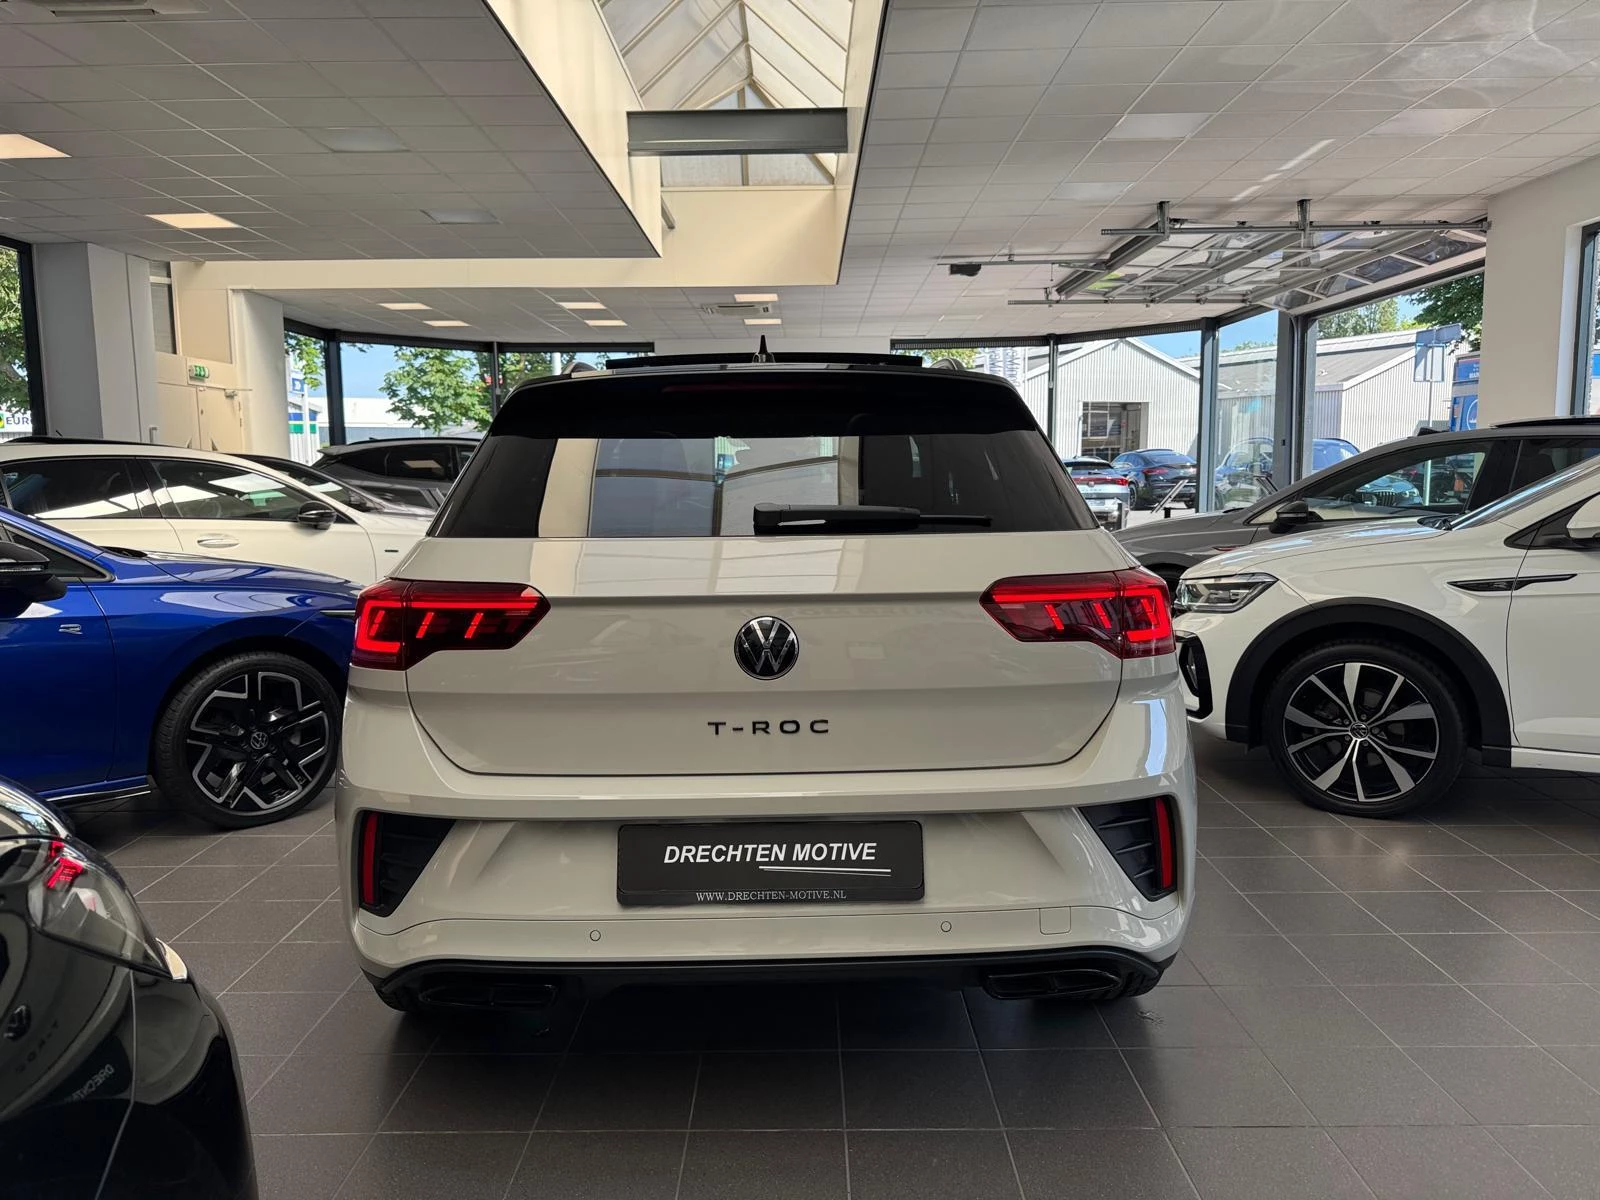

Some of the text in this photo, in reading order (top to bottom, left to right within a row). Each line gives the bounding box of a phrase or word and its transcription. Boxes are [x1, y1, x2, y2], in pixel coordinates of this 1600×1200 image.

[707, 719, 830, 735] T-ROC
[663, 842, 878, 864] DRECHTEN MOTIVE
[695, 889, 847, 902] WWW.DRECHTEN-MOTIVE.NL
